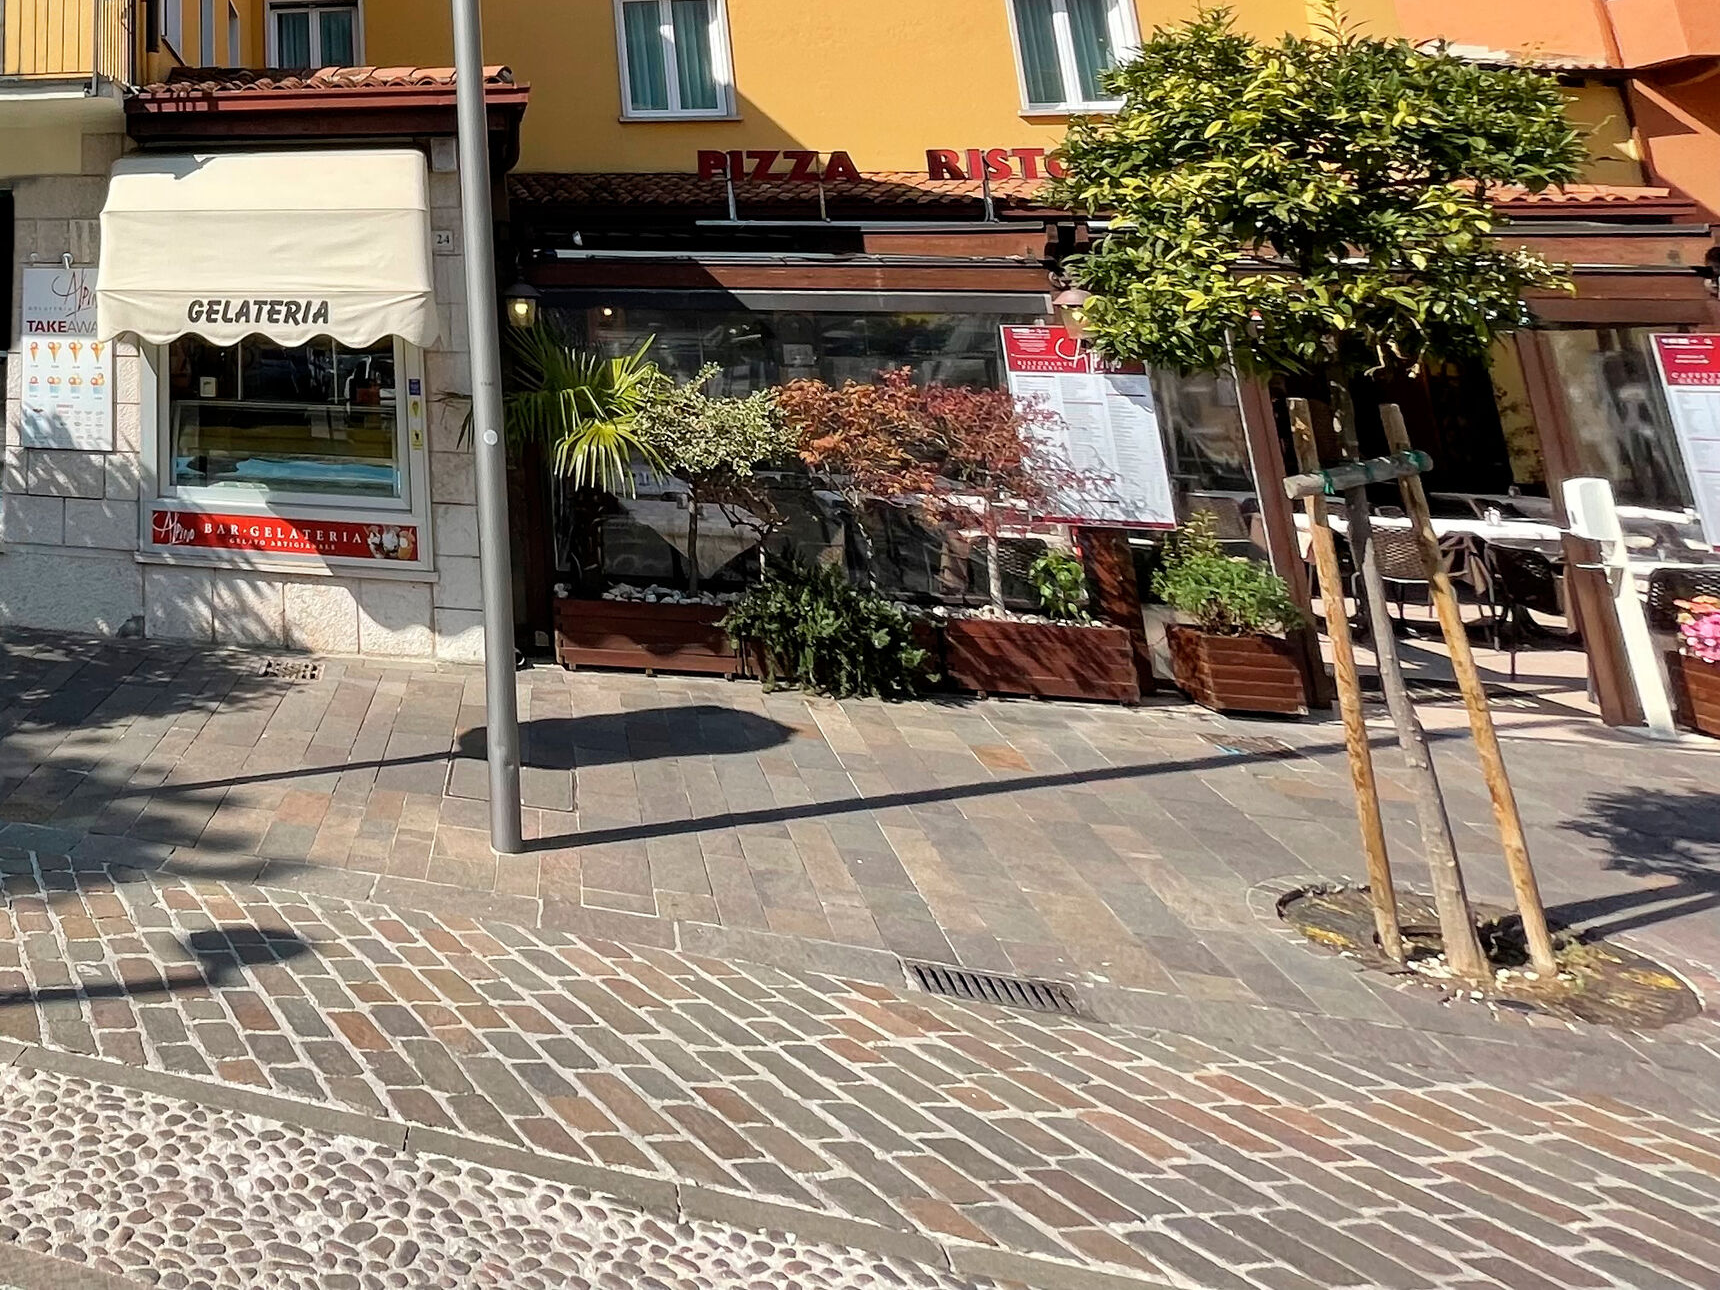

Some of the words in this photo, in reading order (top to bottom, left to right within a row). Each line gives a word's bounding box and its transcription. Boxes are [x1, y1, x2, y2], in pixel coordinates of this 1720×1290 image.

[696, 149, 862, 182] PIZZA
[436, 233, 450, 245] 24
[187, 299, 329, 326] GELATERIA
